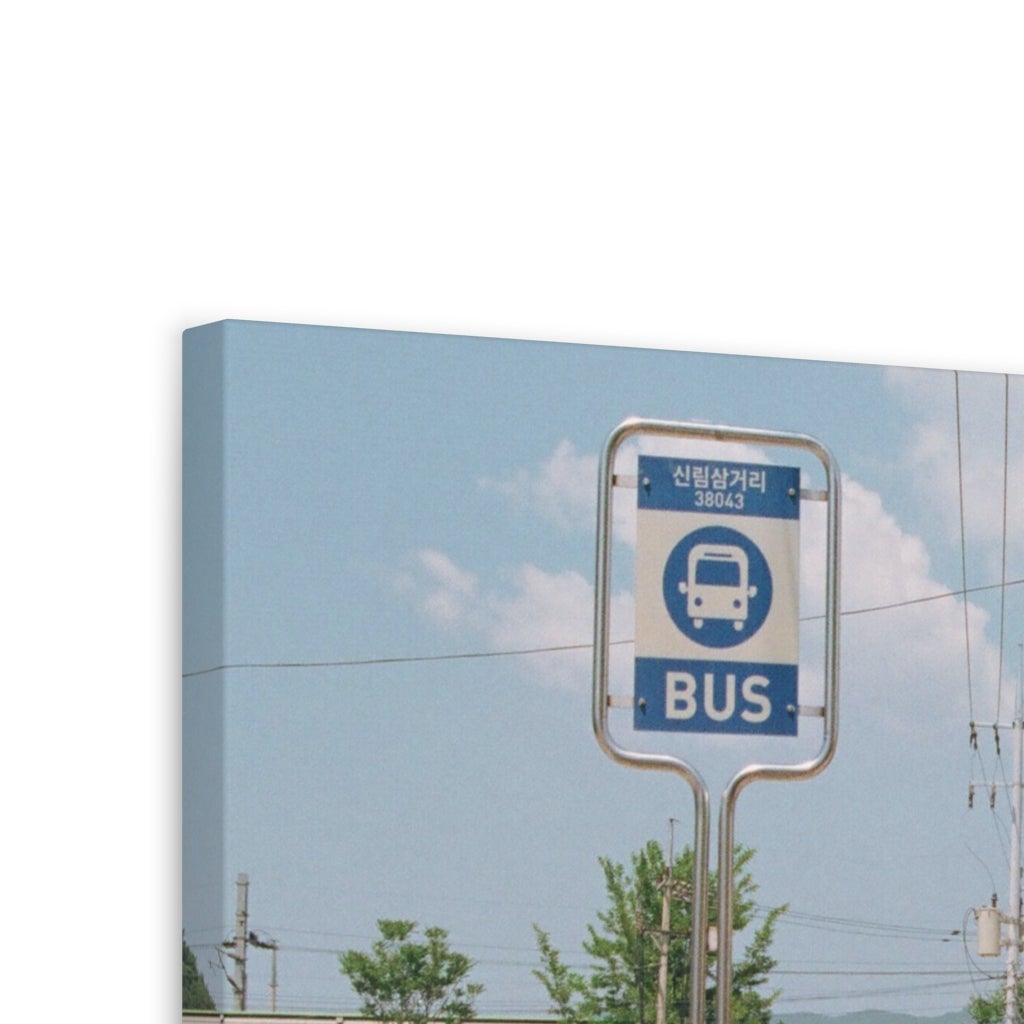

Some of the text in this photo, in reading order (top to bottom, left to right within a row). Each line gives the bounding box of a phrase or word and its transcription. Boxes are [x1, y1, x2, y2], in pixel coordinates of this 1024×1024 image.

[672, 464, 767, 493] 신림삼거리
[694, 490, 745, 509] 38043
[664, 670, 773, 724] BUS
